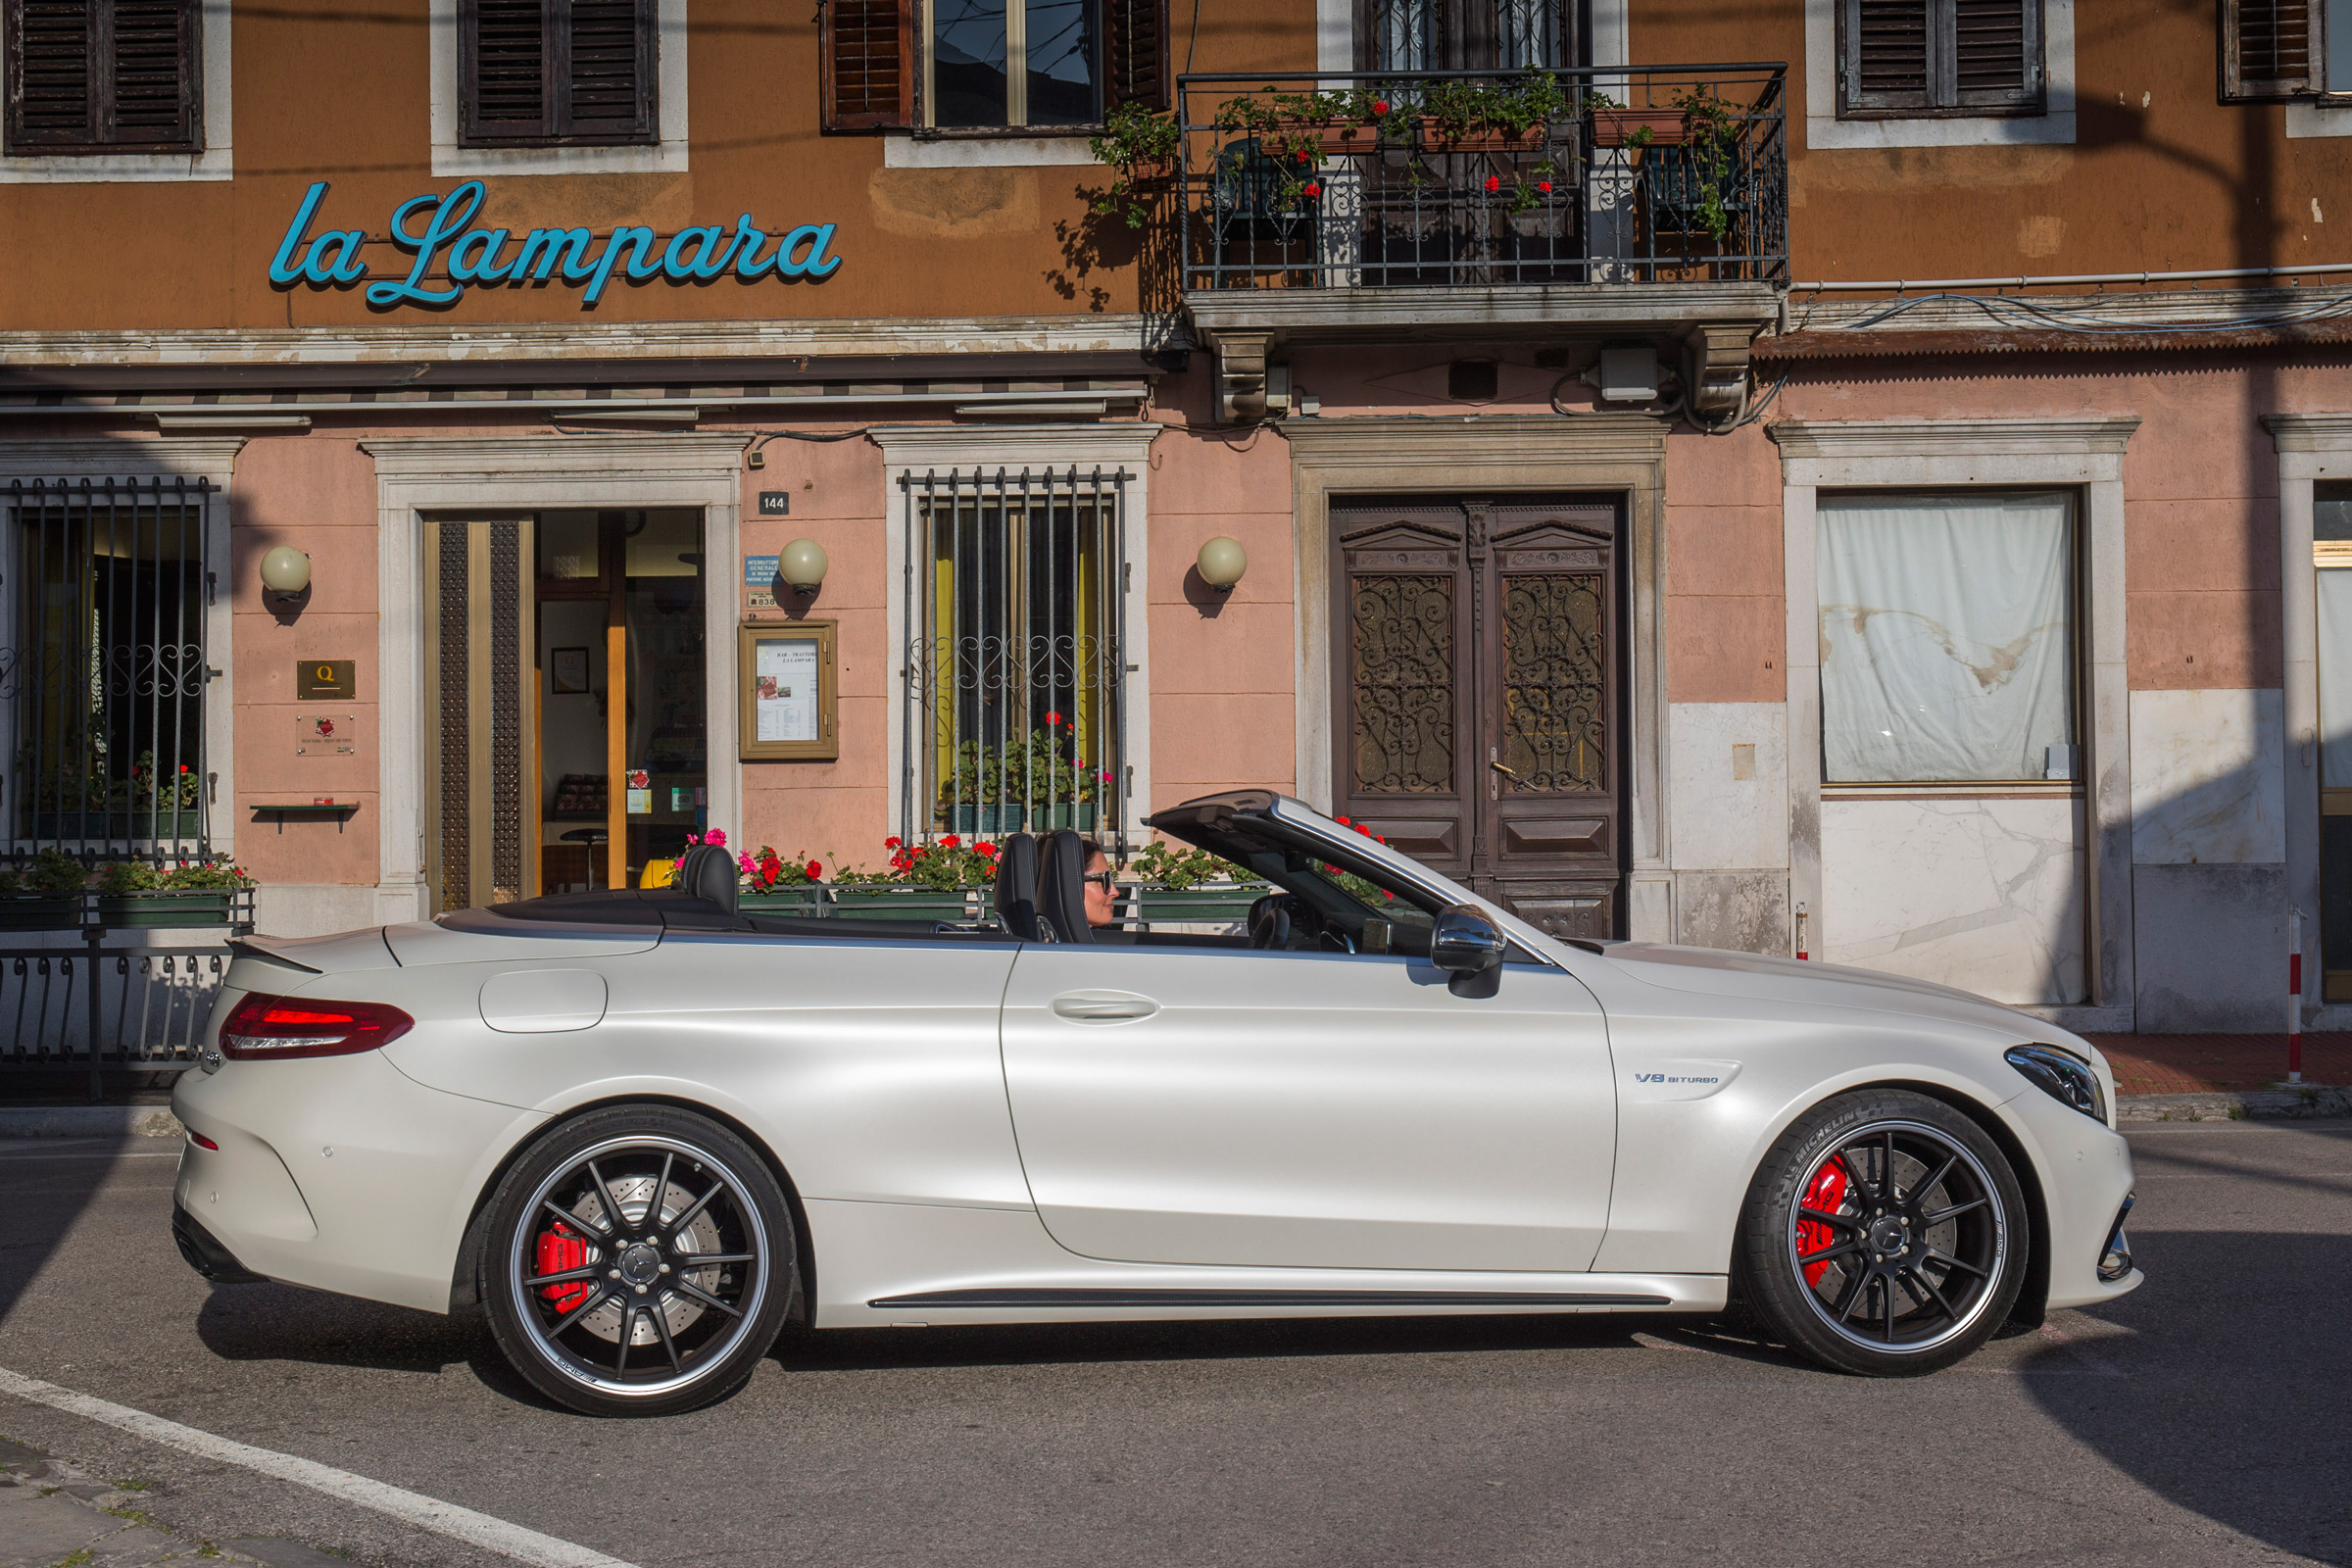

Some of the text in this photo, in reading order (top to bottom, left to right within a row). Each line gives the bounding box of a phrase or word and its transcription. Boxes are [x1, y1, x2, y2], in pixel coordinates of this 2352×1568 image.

[270, 180, 843, 306] la Lampara
[764, 498, 784, 509] 144
[317, 665, 335, 682] Q
[1635, 1073, 1665, 1083] V8
[1795, 1110, 1855, 1163] MICHELIN
